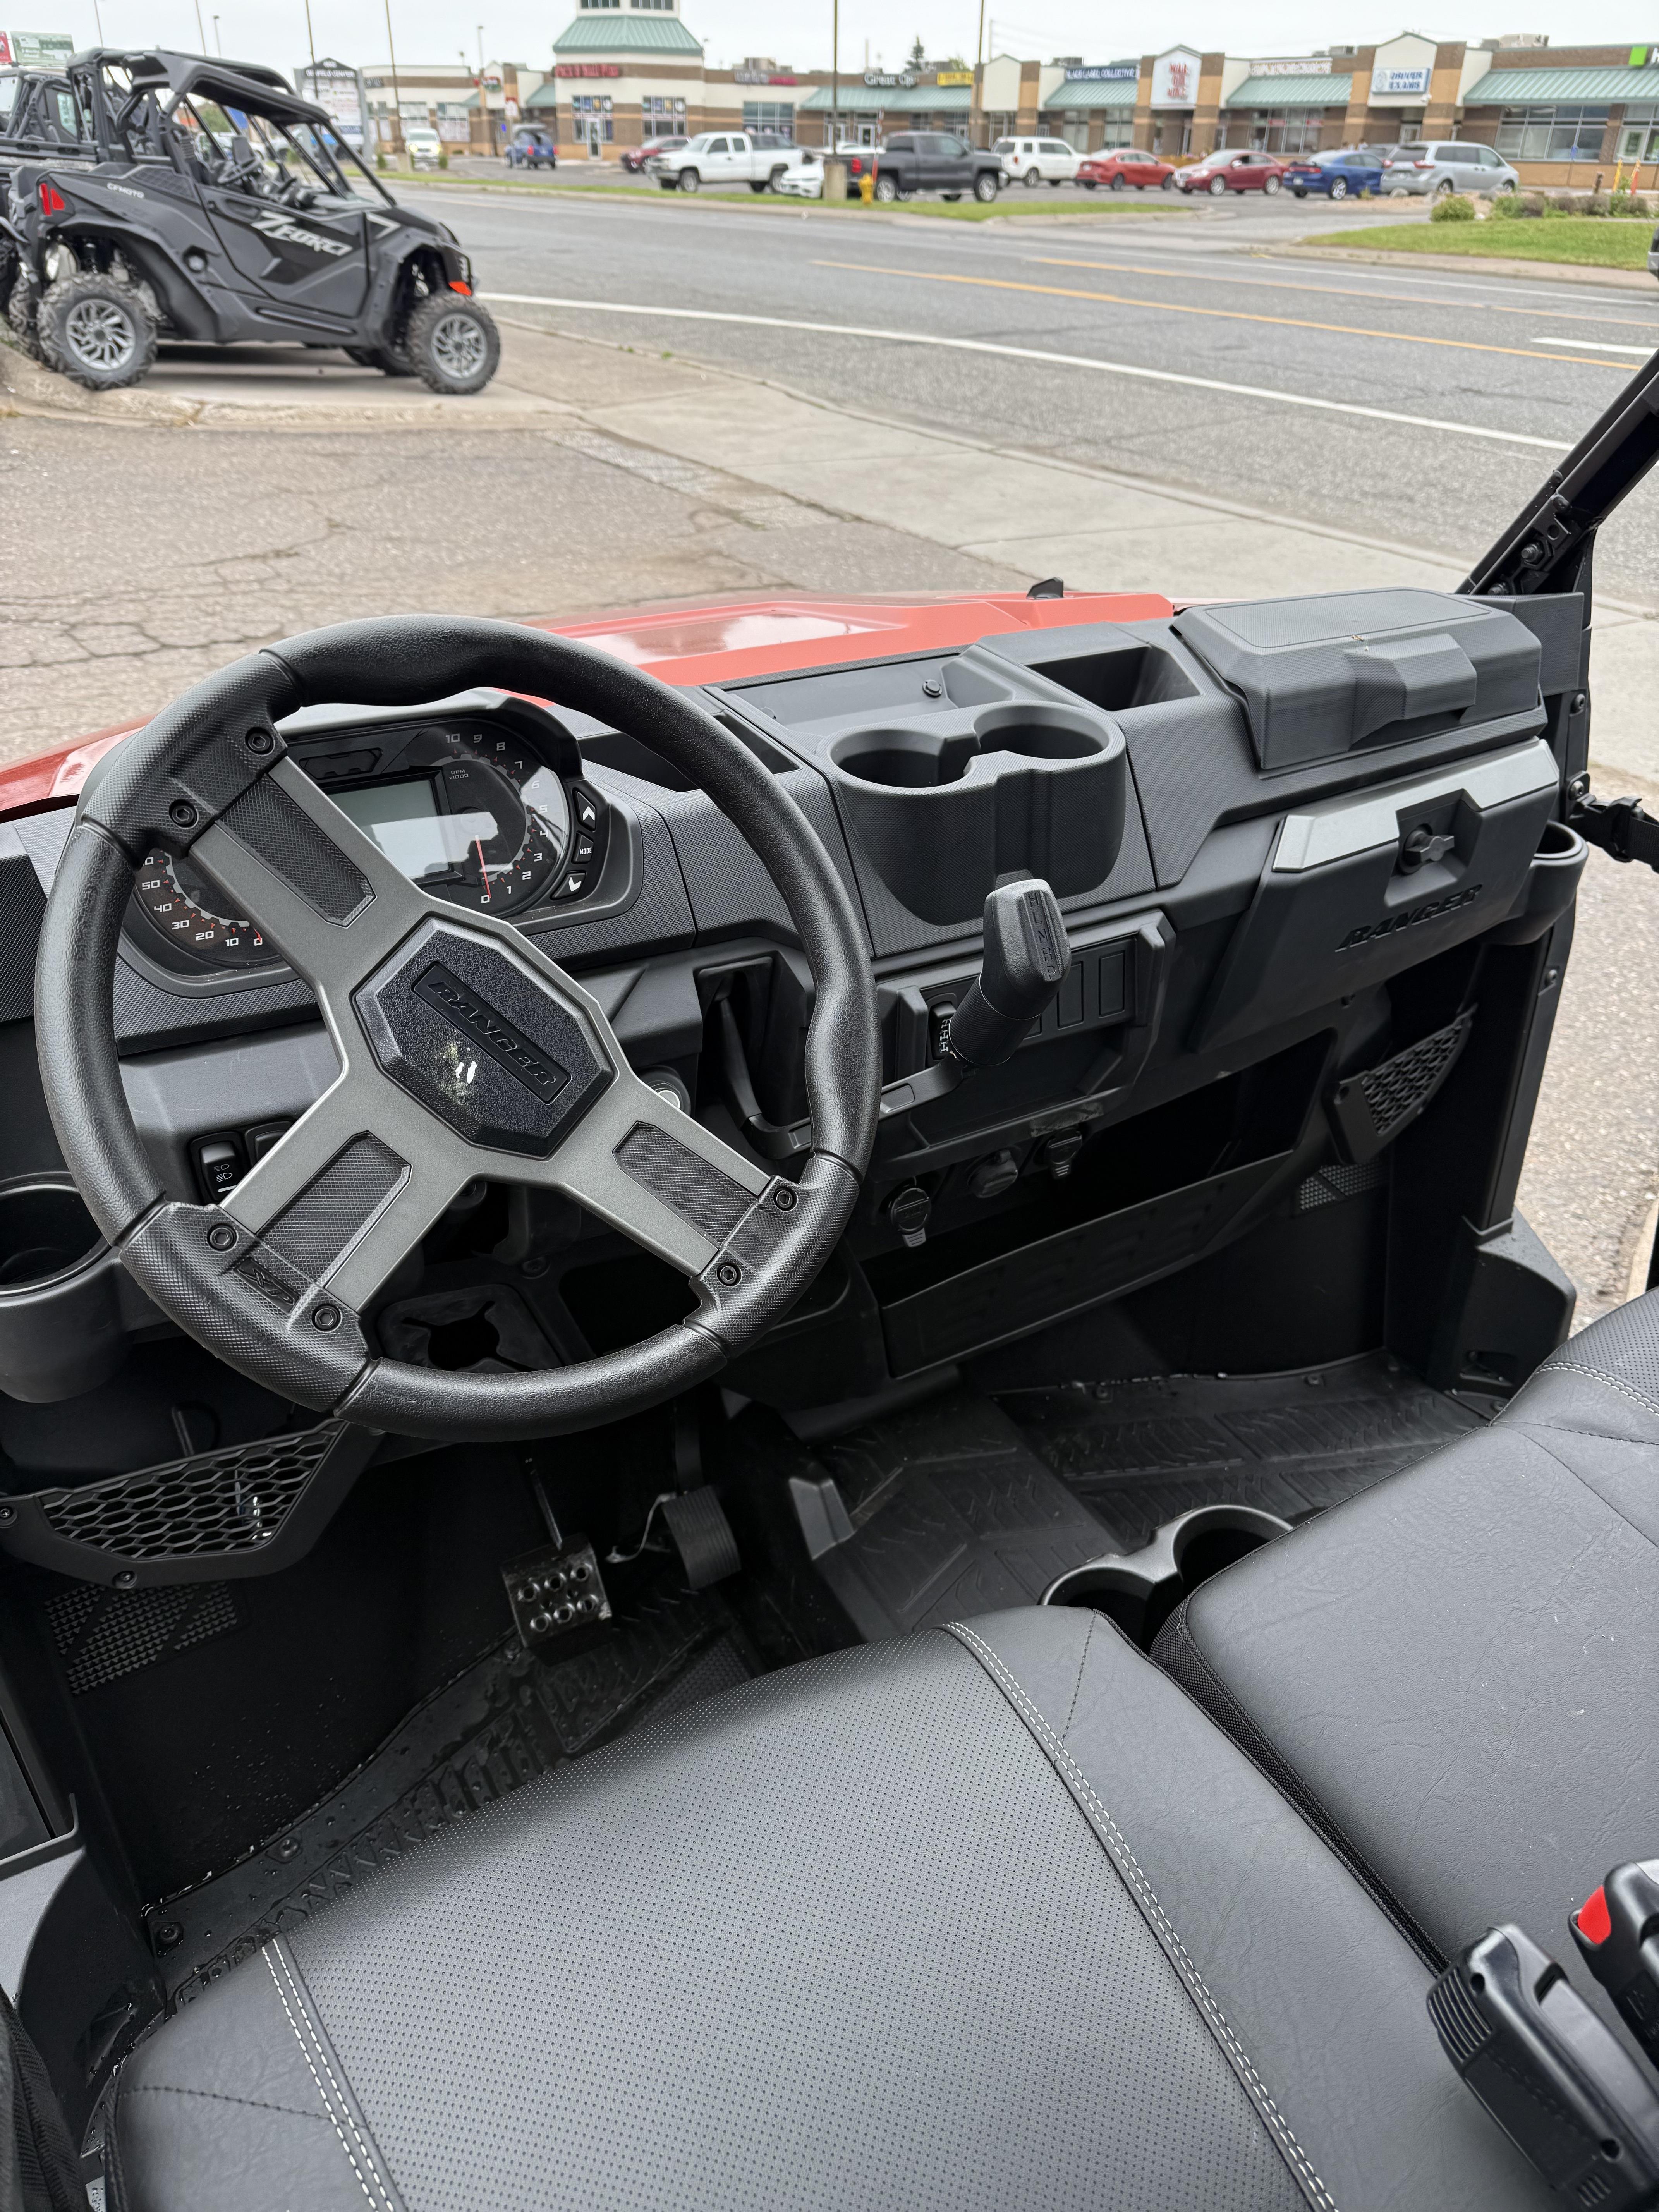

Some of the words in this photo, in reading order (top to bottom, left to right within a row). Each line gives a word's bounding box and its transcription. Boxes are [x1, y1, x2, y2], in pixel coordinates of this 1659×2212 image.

[107, 182, 144, 198] CFMOTO
[446, 733, 460, 743] 10
[473, 734, 482, 743] 9
[496, 742, 505, 751] 8
[514, 761, 523, 769] 7
[531, 780, 540, 789] 6
[539, 804, 548, 813] 5
[540, 830, 548, 838] 4
[143, 857, 154, 866] 0
[533, 852, 542, 862] 3
[522, 871, 531, 880] 2
[142, 880, 160, 890] 50
[507, 886, 511, 894] 1
[481, 895, 490, 904] 0
[1028, 892, 1039, 908] H
[154, 903, 172, 913] 40
[1032, 912, 1043, 924] L
[1334, 884, 1483, 953] RANGER
[172, 919, 189, 930] 30
[196, 931, 214, 941] 20
[1037, 929, 1048, 944] N
[225, 938, 239, 947] 10
[254, 938, 263, 946] 0
[1041, 947, 1053, 961] R
[1046, 965, 1056, 980] P
[427, 981, 556, 1085] RANGER
